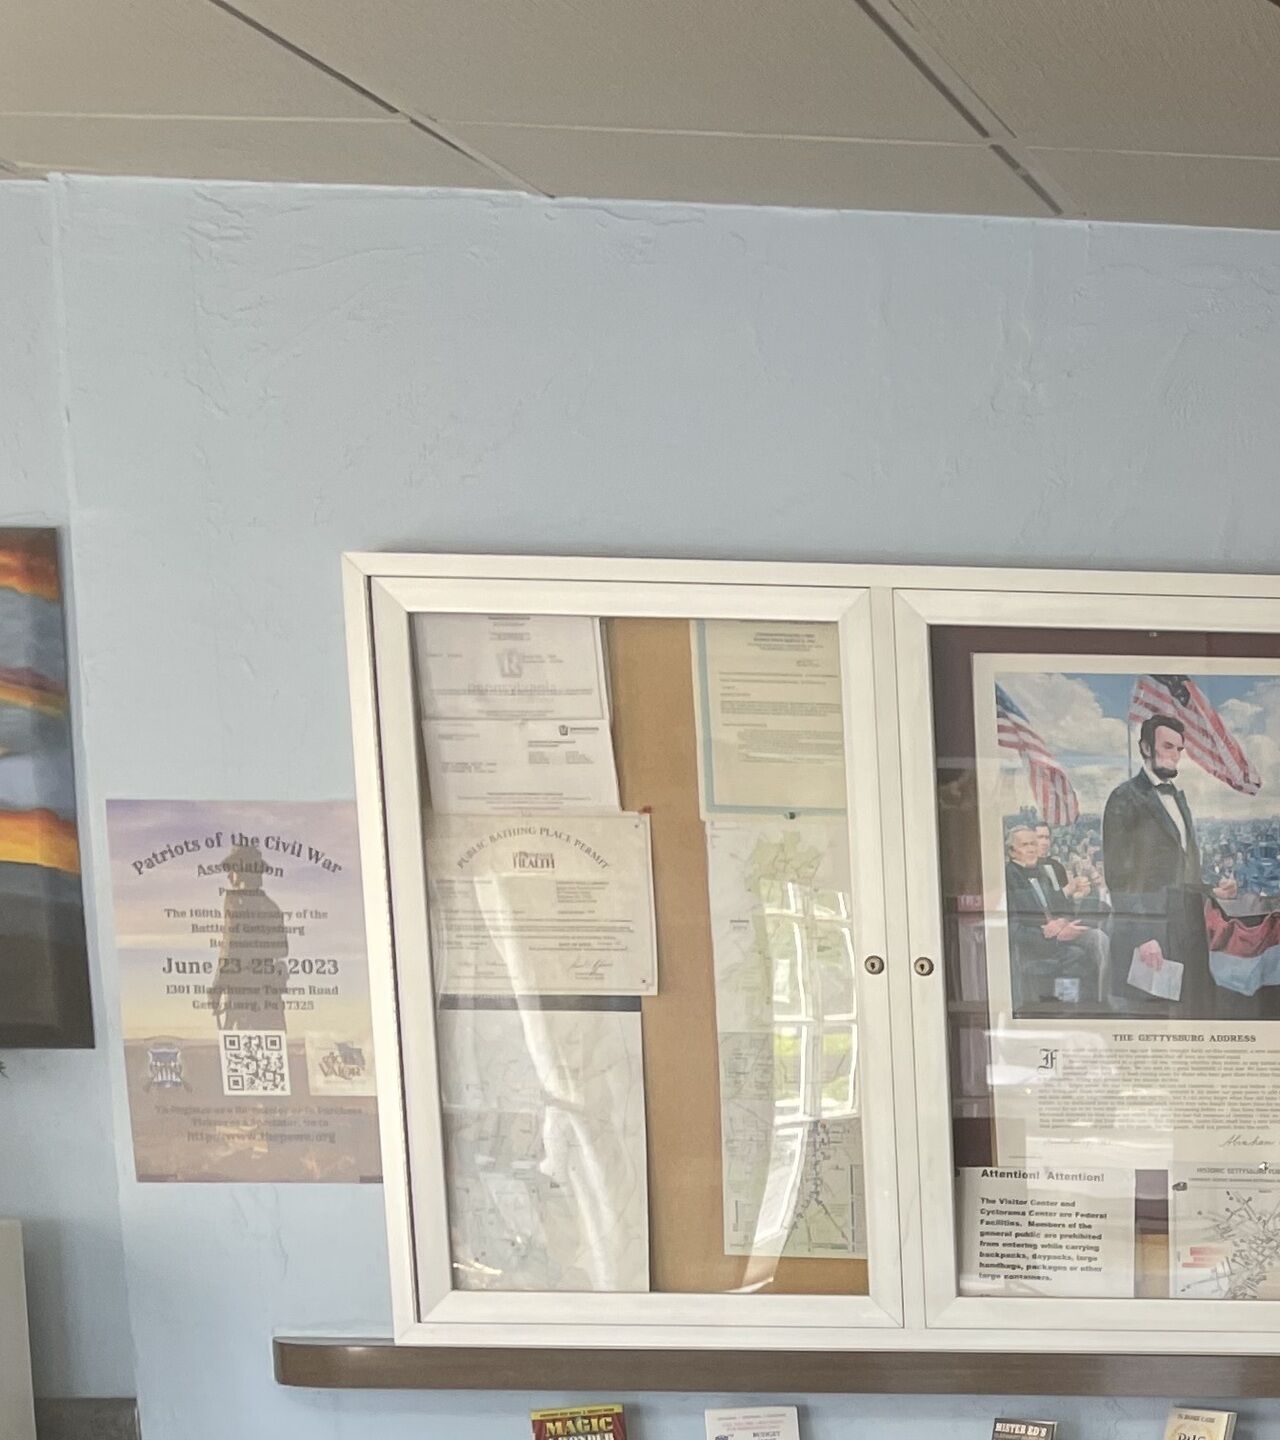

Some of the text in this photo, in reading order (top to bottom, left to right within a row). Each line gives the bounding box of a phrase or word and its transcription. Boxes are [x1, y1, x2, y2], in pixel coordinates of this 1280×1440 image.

[131, 832, 343, 876] Patriots of the Civil War
[196, 862, 284, 878] Association
[162, 957, 213, 975] June
[288, 958, 340, 975] 2023
[1112, 1034, 1257, 1043] THE GETTYSBURG ADDRESS
[980, 1169, 1105, 1183] Attention! Attention!
[545, 1416, 614, 1437] MAGIC
[995, 1422, 1027, 1434] MISTER
